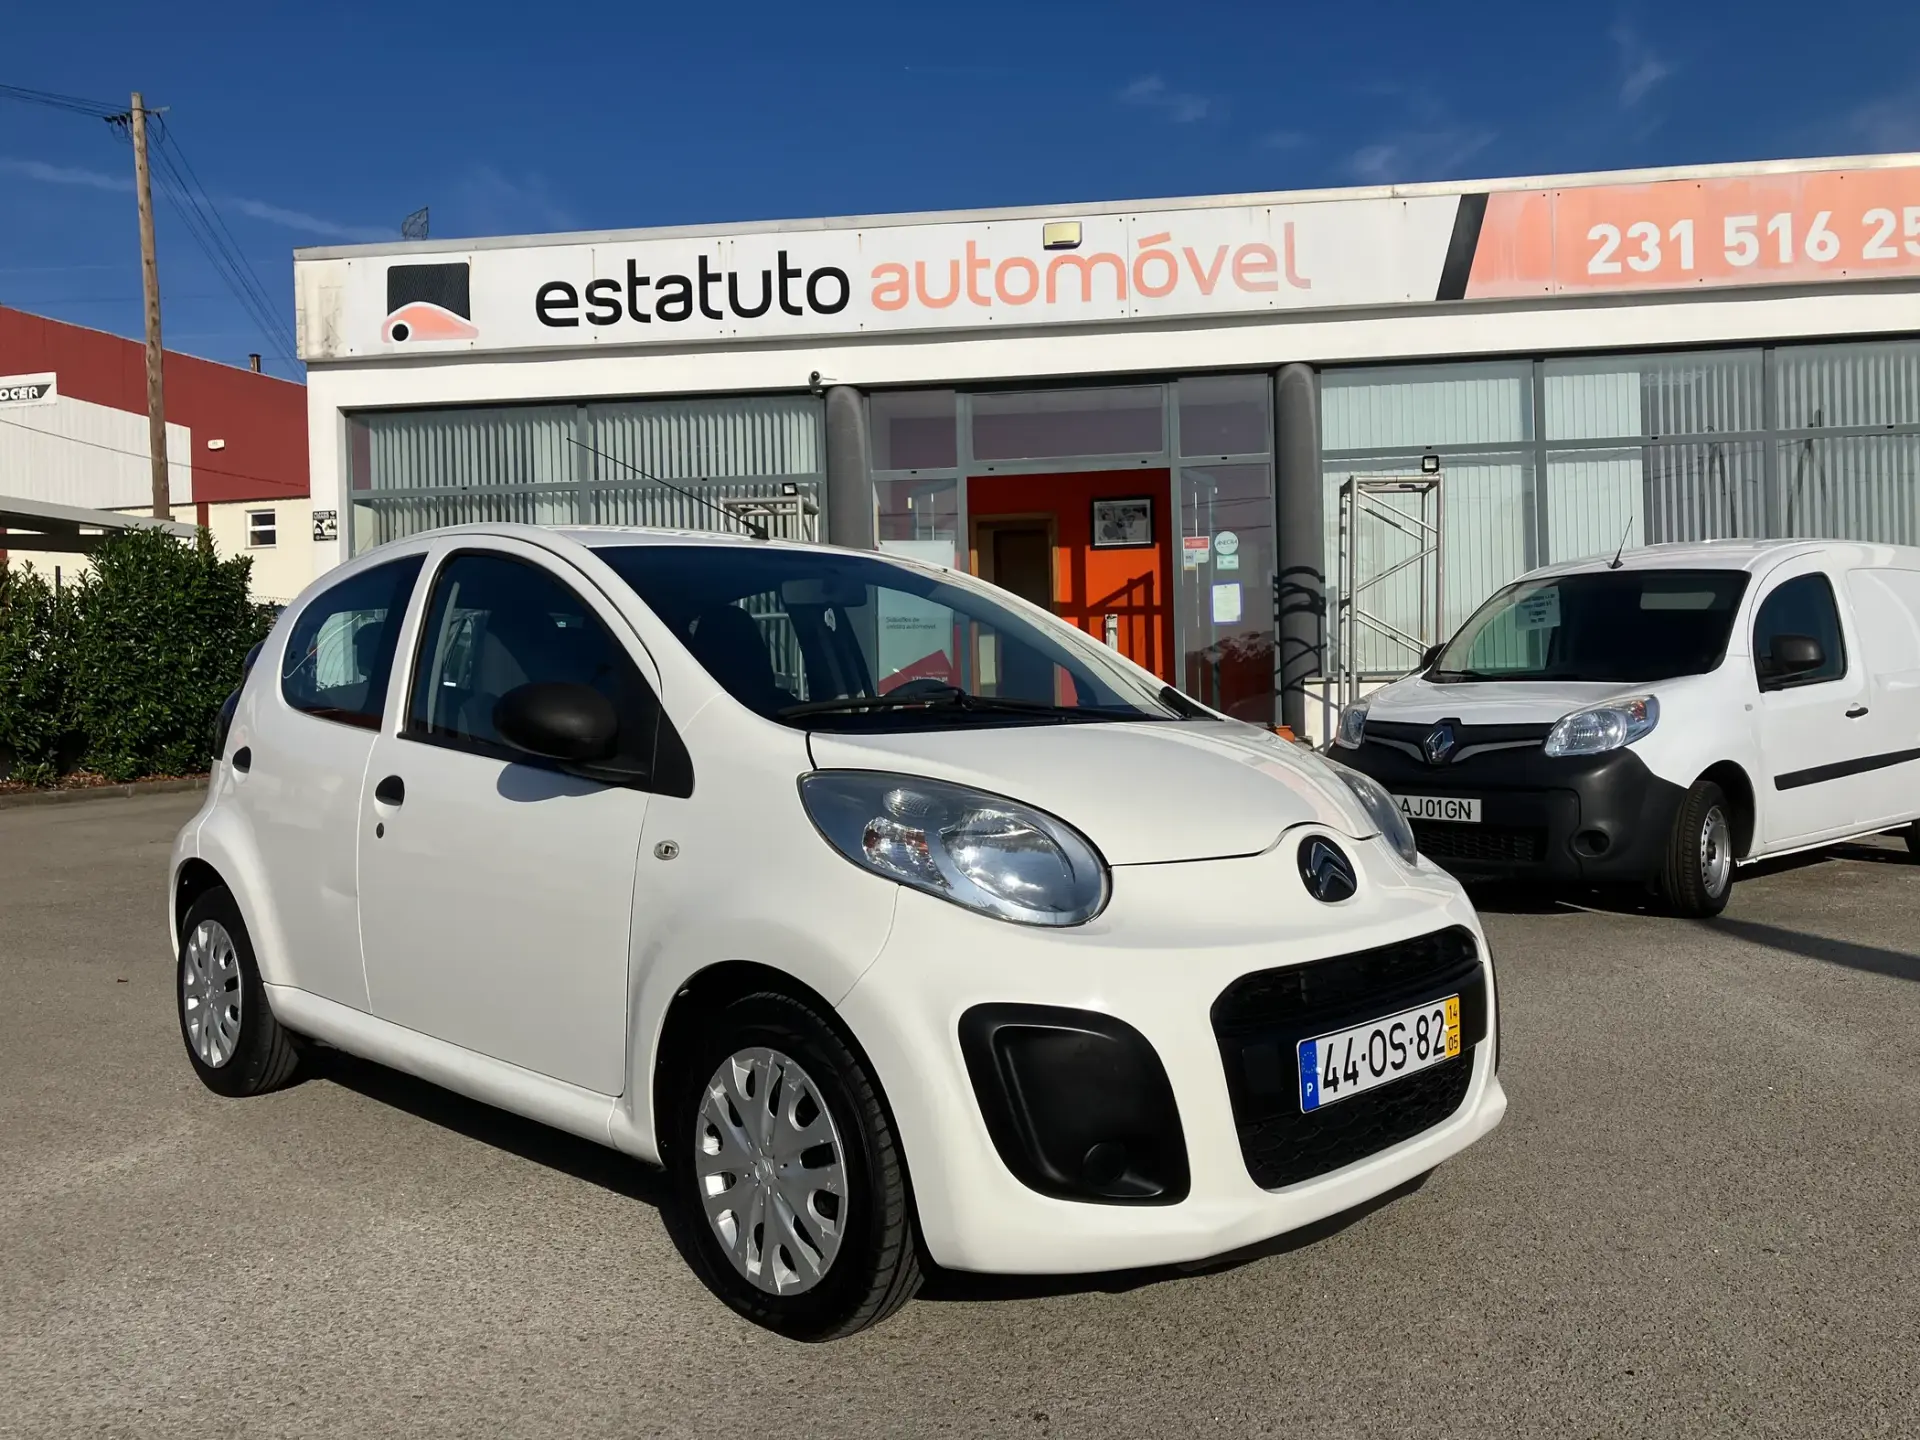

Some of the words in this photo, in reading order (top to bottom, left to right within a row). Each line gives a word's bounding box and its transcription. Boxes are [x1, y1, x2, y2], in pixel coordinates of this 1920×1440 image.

[1587, 219, 1694, 274] 231
[1724, 210, 1840, 266] 516
[535, 250, 850, 327] estatuto
[871, 222, 1311, 312] automóvel
[1401, 797, 1471, 820] AJ01GN
[1449, 1004, 1457, 1020] 14
[1449, 1034, 1458, 1051] 05
[1307, 1083, 1313, 1096] P
